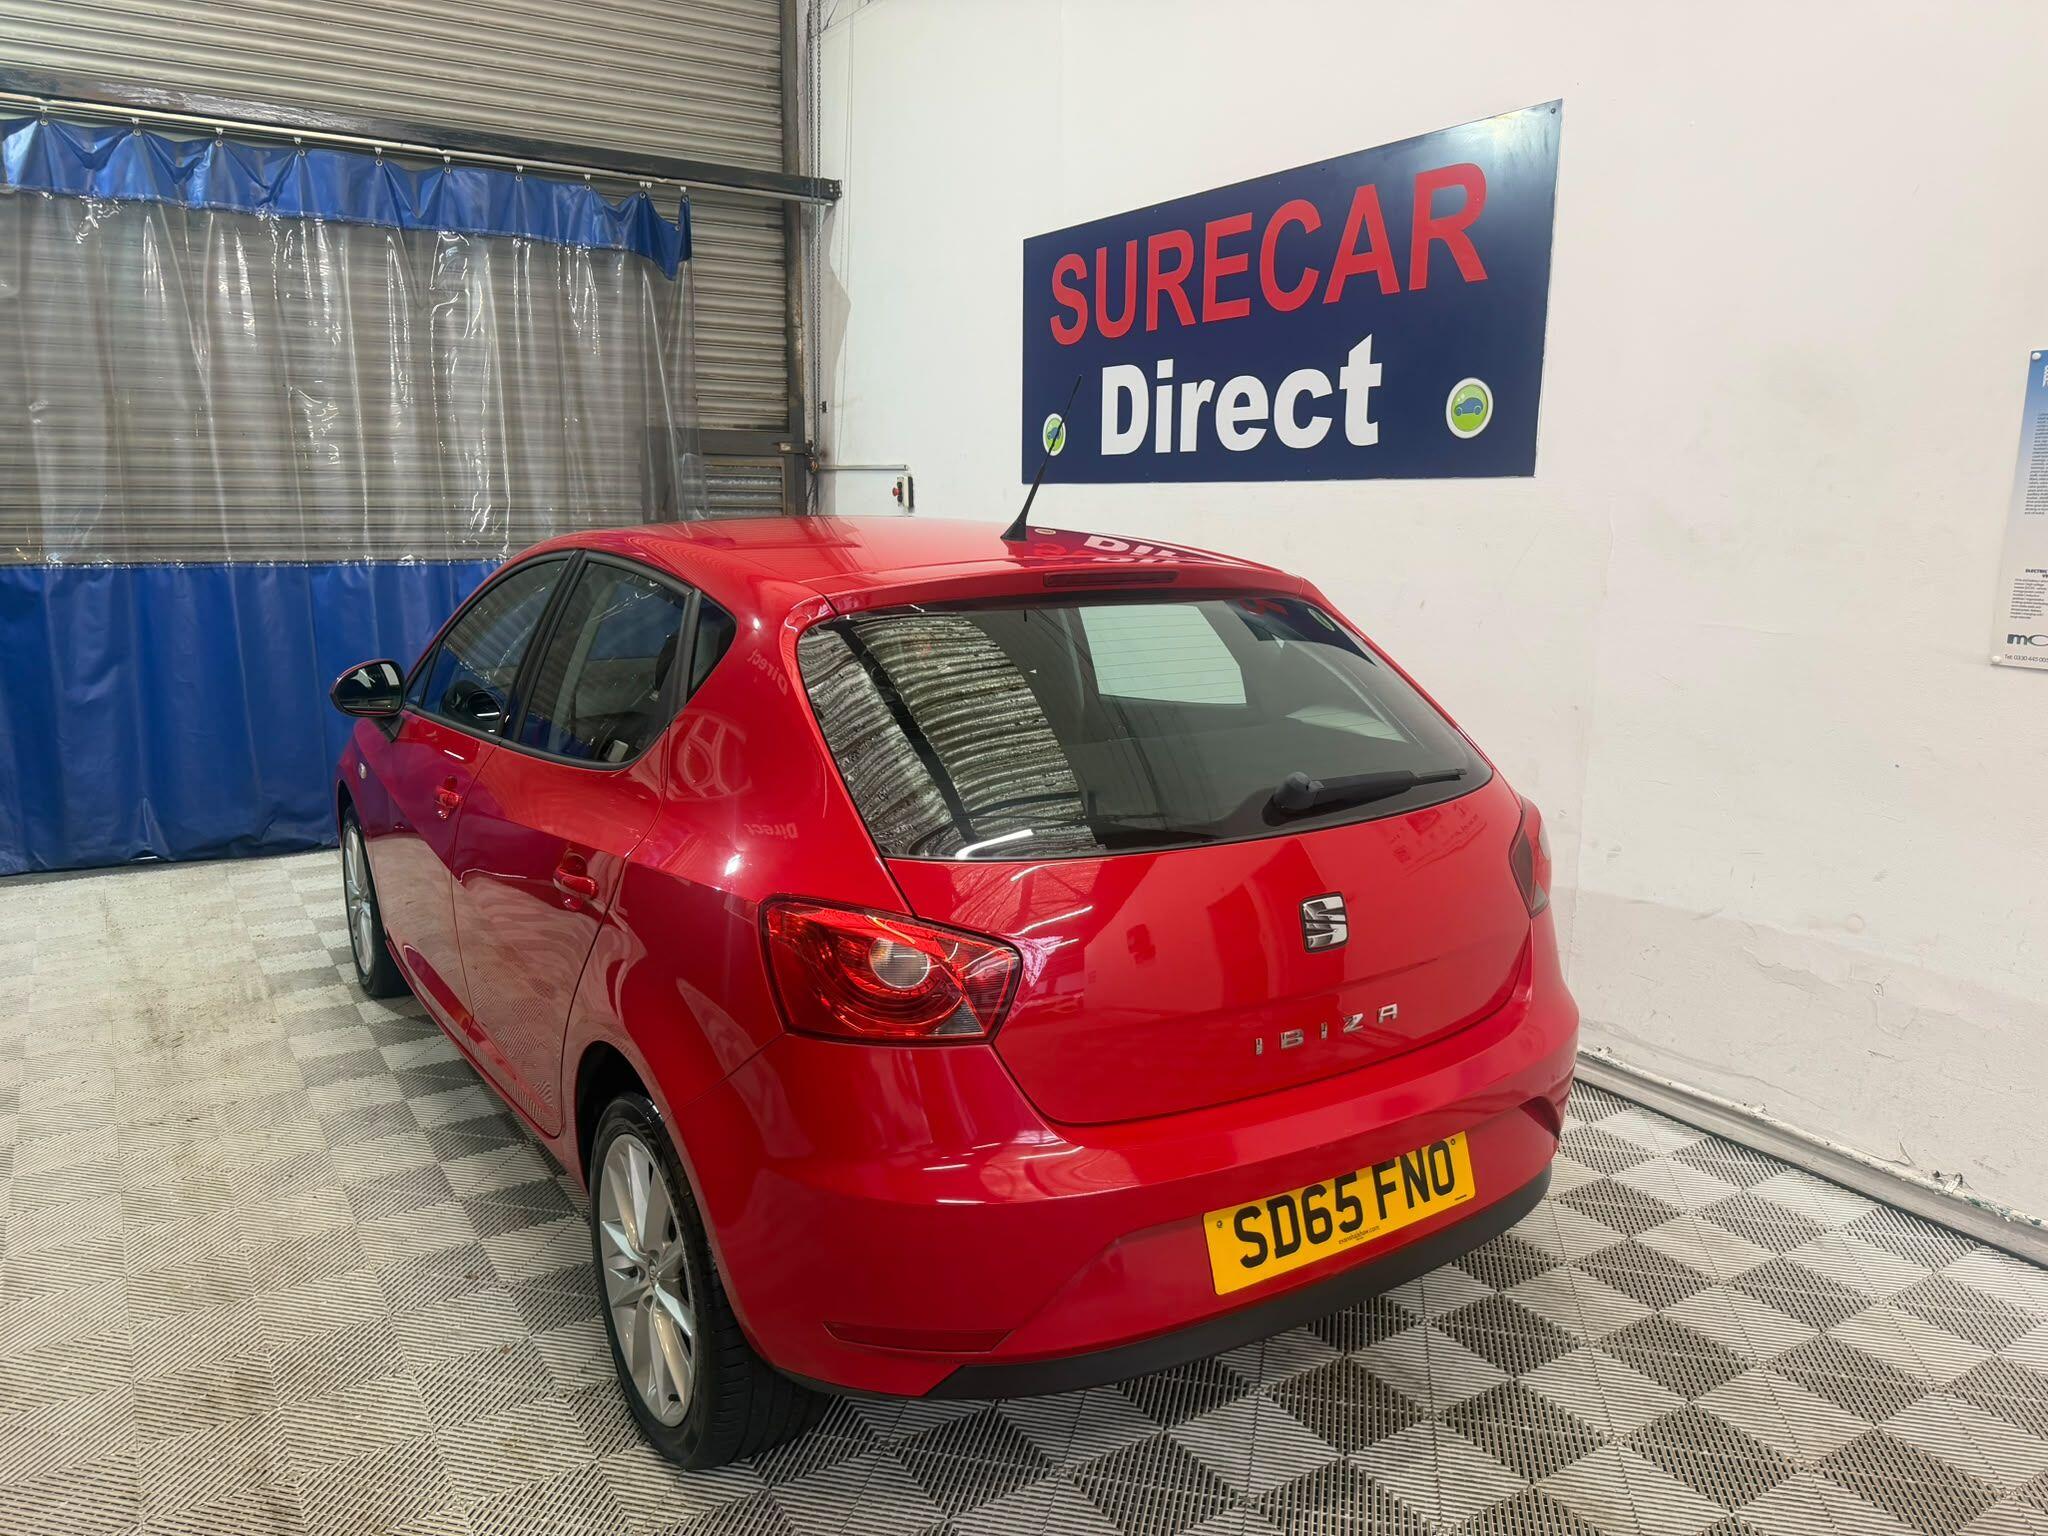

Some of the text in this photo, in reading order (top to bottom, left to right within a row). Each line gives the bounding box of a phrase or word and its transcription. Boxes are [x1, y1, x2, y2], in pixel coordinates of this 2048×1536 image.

[1050, 162, 1489, 346] SURECAR
[1101, 333, 1383, 457] Direct
[1255, 1003, 1398, 1056] IBIZA
[1233, 1140, 1456, 1269] SD65 FNO
